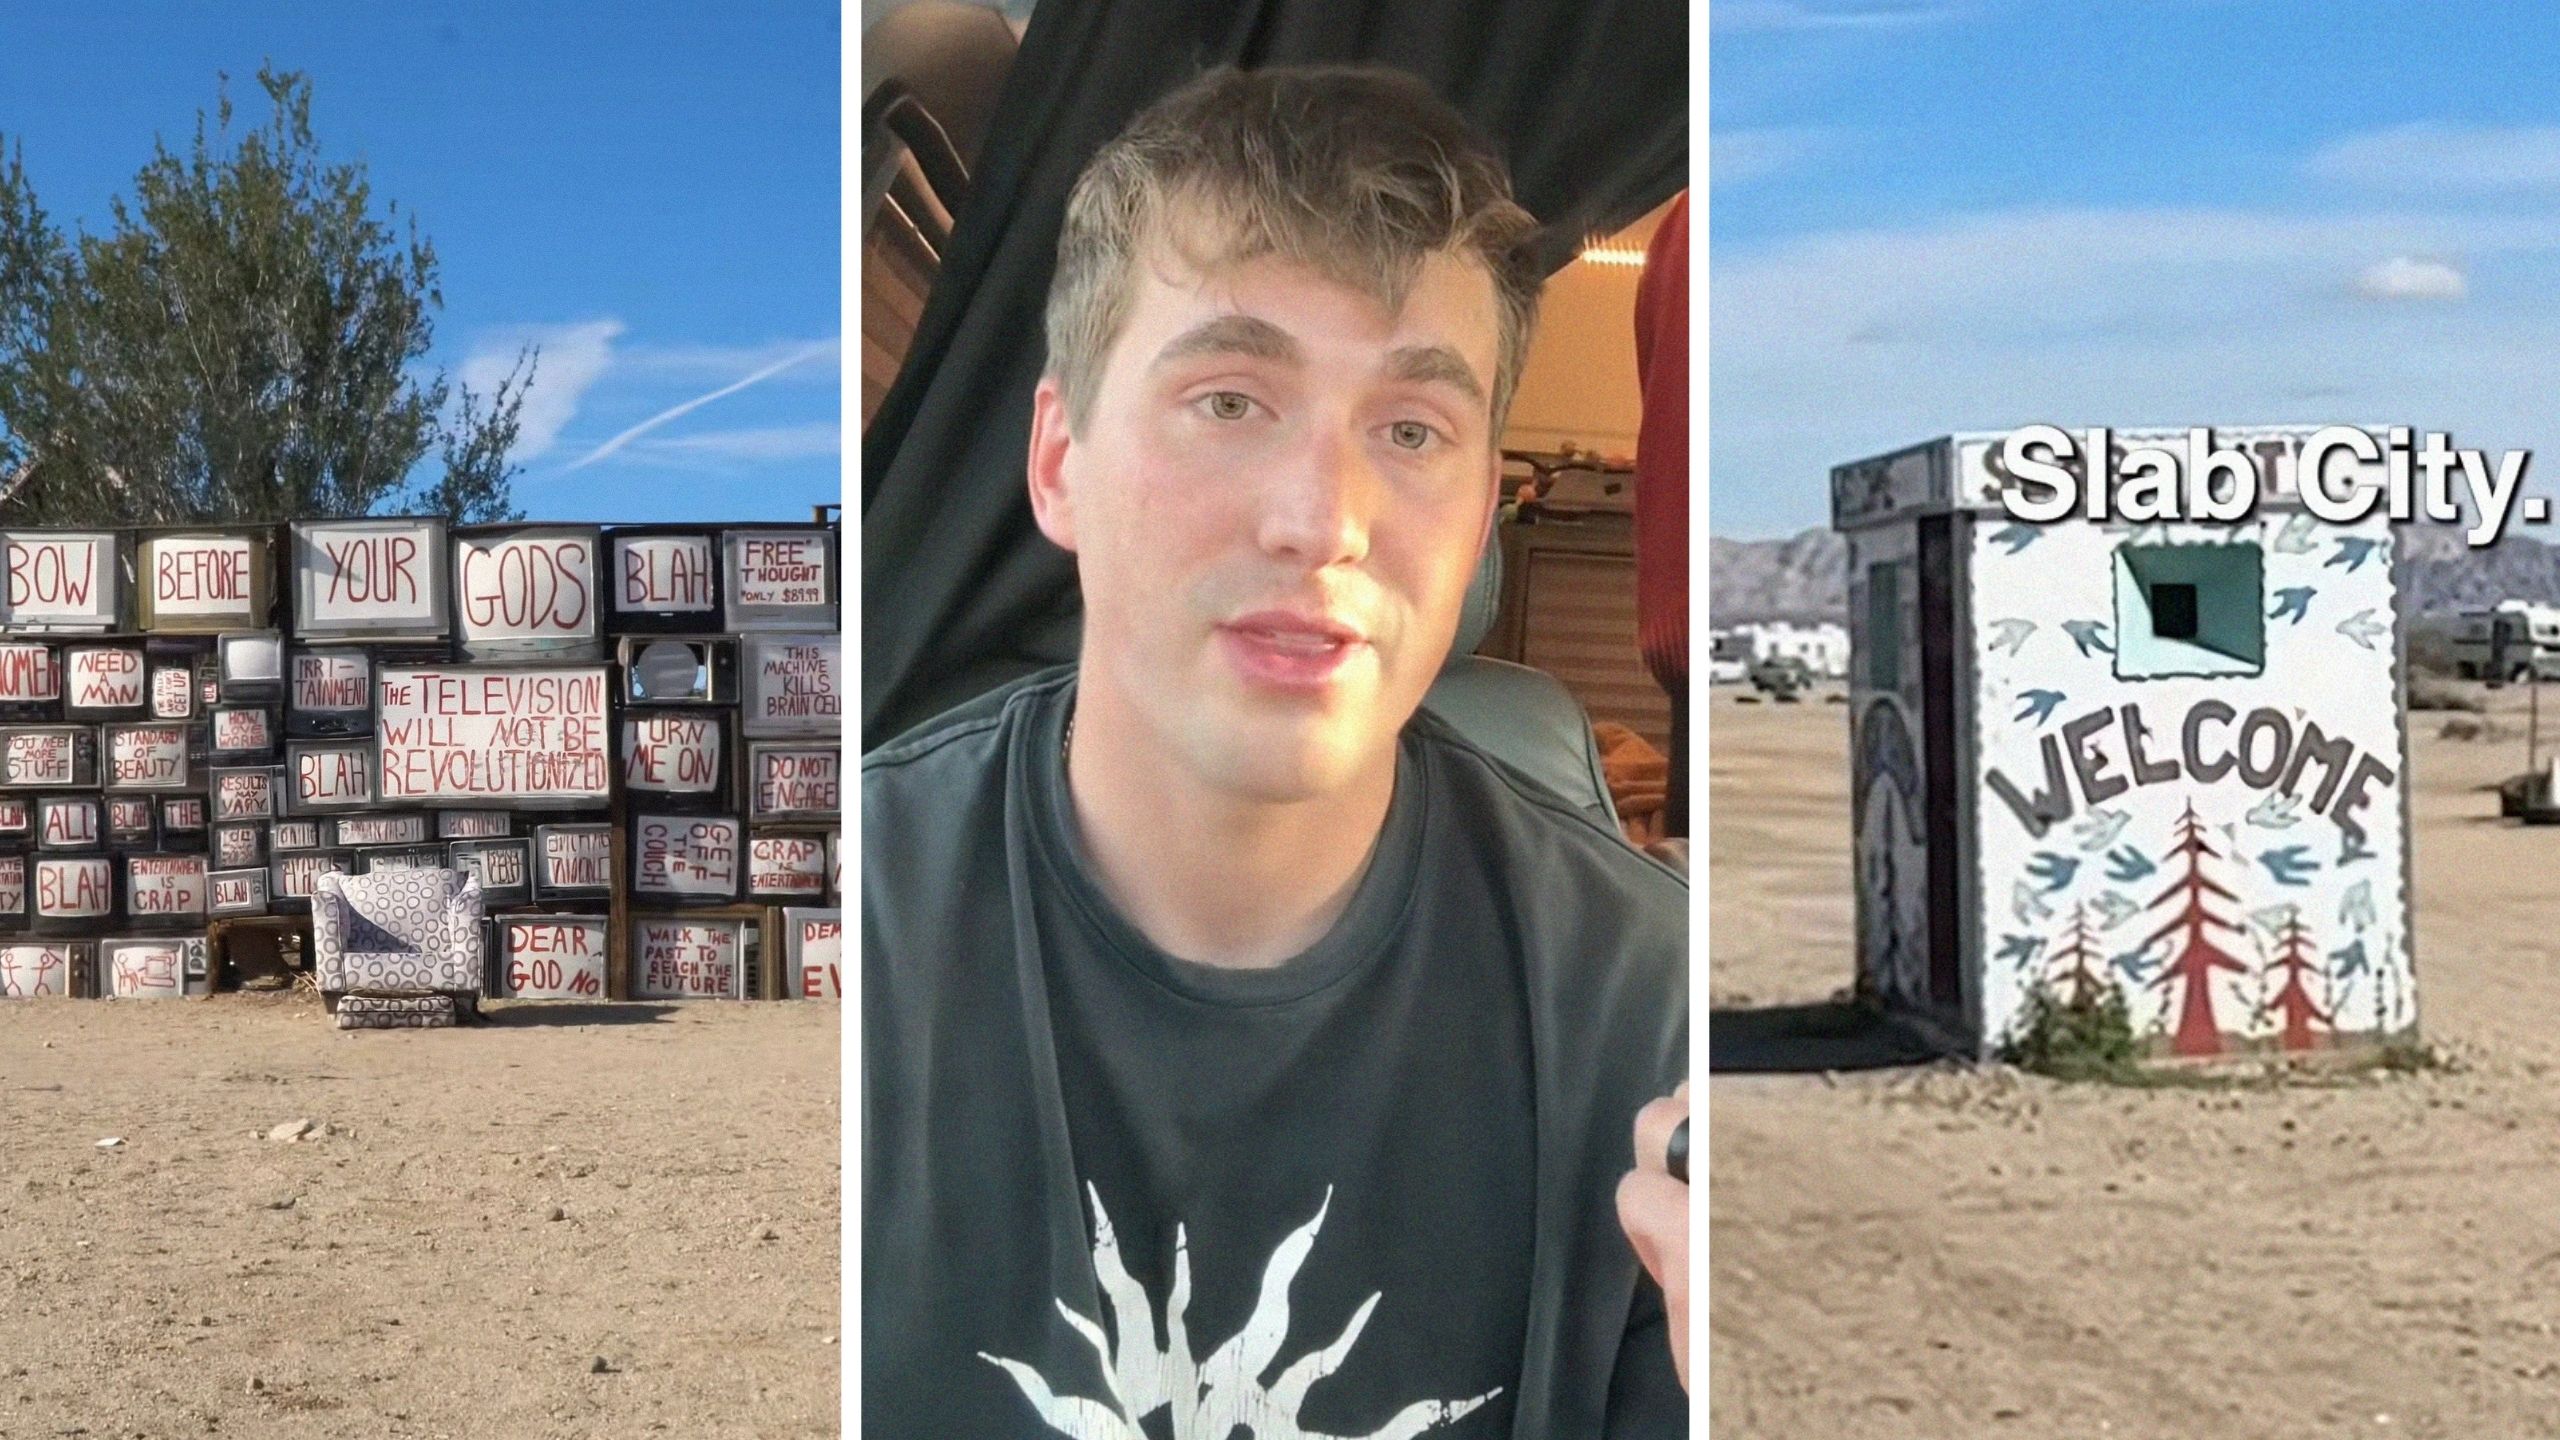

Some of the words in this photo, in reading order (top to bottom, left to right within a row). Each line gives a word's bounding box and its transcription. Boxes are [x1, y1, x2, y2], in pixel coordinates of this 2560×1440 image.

[7, 543, 93, 607] BOW
[159, 549, 249, 601] BEFORE
[326, 537, 417, 604] YOUR
[625, 545, 710, 604] BLAH
[741, 564, 821, 583] THOUGHT
[464, 543, 586, 630] GODS
[781, 588, 819, 603] $89.99
[78, 653, 138, 673] NEED
[784, 647, 819, 660] THIS
[0, 648, 59, 696] OMEN
[764, 659, 827, 675] MACHINE
[100, 672, 110, 687] A
[173, 673, 186, 688] UP
[783, 674, 831, 696] KILLS
[80, 684, 138, 704] MAN
[173, 693, 186, 712] GET
[295, 676, 366, 707] TAINMENT
[381, 681, 411, 706] THE
[412, 674, 601, 715] TELEVISION
[767, 696, 809, 717] BRAIN
[229, 711, 259, 725] HOW
[115, 730, 179, 747] STANDARD
[220, 724, 263, 737] LOVE
[382, 717, 465, 747] WILL
[490, 716, 555, 749] NOT
[563, 716, 602, 751] BE
[630, 718, 706, 745] TURN
[7, 736, 35, 750] YOU
[134, 746, 157, 759] OF
[24, 749, 57, 760] MORE
[627, 744, 668, 783] ME
[678, 747, 714, 784] ON
[7, 757, 68, 779] STUFF
[113, 754, 181, 780] BEAUTY
[299, 752, 366, 798] BLAH
[383, 748, 607, 795] REVOLUTIONIZED
[768, 755, 795, 779] DO
[800, 757, 832, 779] NOT
[219, 775, 267, 790] RESULTS
[1985, 699, 2394, 866] WELCOME
[235, 790, 258, 798] MAY
[760, 781, 837, 809] ENGAGE
[0, 806, 24, 826] LAH
[113, 804, 147, 827] BLAH
[166, 802, 200, 825] THE
[223, 798, 267, 814] VARY
[46, 804, 96, 840] ALL
[640, 824, 668, 887] COUCH
[672, 834, 687, 873] THE
[688, 823, 709, 880] OFF
[710, 824, 733, 884] GET
[754, 840, 817, 862] CRAP
[779, 861, 794, 871] IS
[40, 865, 110, 911] BLAH
[161, 876, 175, 889] IS
[215, 878, 248, 903] BLAH
[134, 889, 192, 912] CRAP
[507, 924, 589, 956] DEAR
[647, 927, 692, 943] WALK
[704, 928, 731, 946] THE
[645, 945, 687, 960] PAST
[697, 945, 717, 962] TO
[506, 959, 562, 992] GOD
[567, 968, 599, 995] NO
[650, 960, 698, 975] REACH
[705, 963, 732, 977] THE
[646, 974, 729, 994] FUTURE
